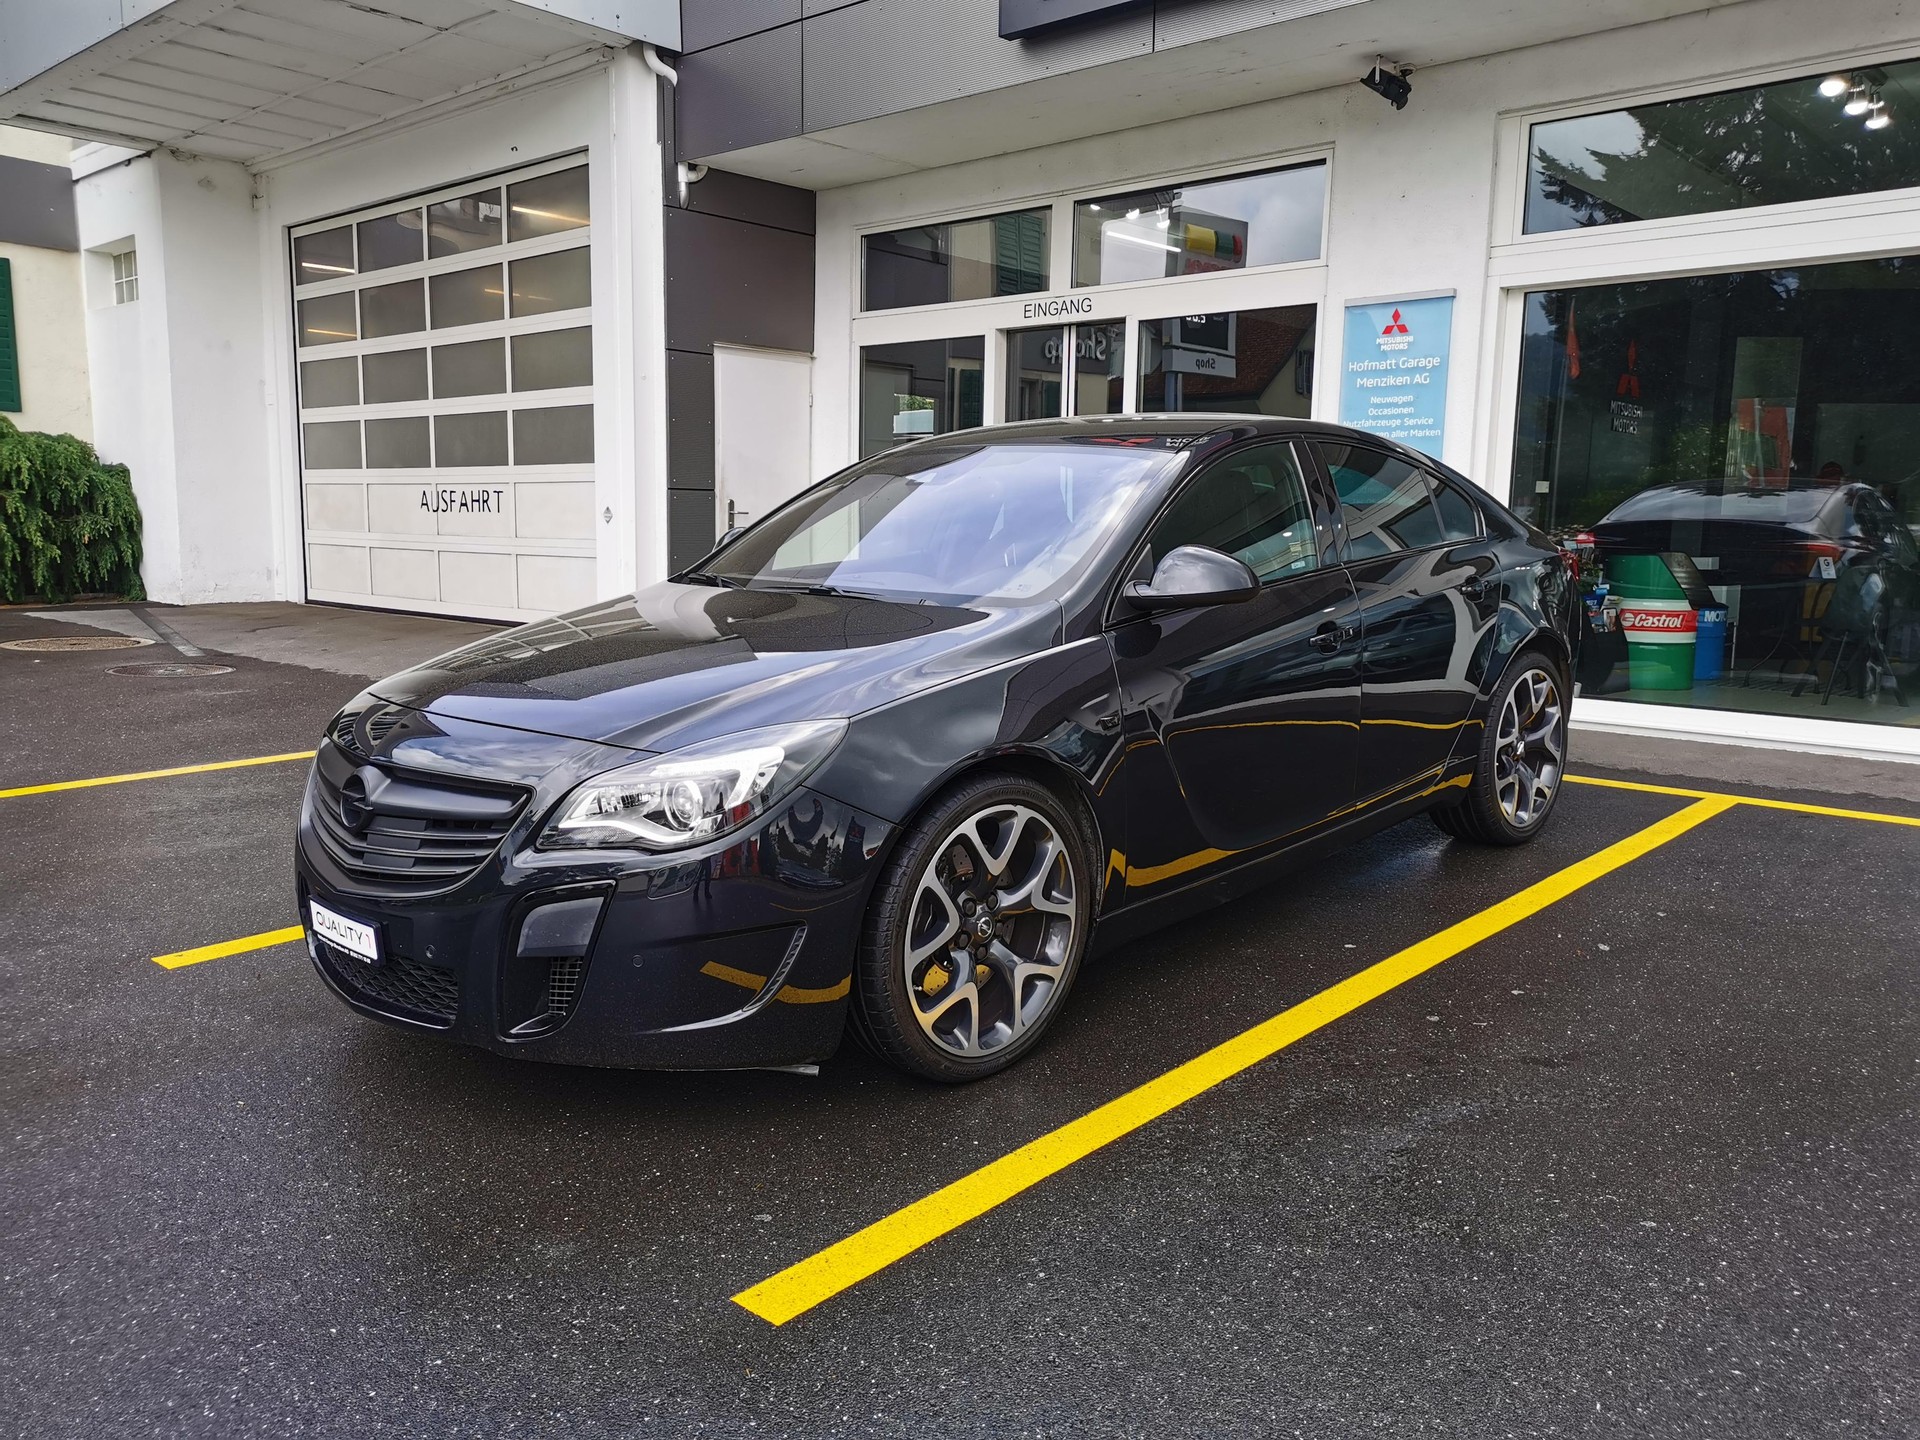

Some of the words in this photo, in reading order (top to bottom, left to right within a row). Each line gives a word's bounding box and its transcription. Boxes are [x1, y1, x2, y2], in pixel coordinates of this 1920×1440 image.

[1023, 297, 1092, 319] EINGANG
[1376, 336, 1413, 344] MITSUBISHI
[1380, 343, 1409, 351] MOTORS
[1348, 359, 1397, 372] Hofmatt
[1399, 356, 1441, 369] Garage
[1356, 375, 1410, 388] Menziken
[1413, 373, 1430, 385] AG
[1370, 395, 1414, 404] Neuwagen
[1368, 406, 1415, 416] Occasionen
[1343, 418, 1402, 427] Nutzfahrzeuge
[1403, 416, 1434, 426] Service
[1391, 429, 1409, 438] aller
[1409, 428, 1441, 437] Marken
[421, 489, 504, 513] AUSFAHRT
[1634, 613, 1682, 628] Castrol
[315, 911, 363, 945] QUALITY
[365, 933, 371, 949] 1
